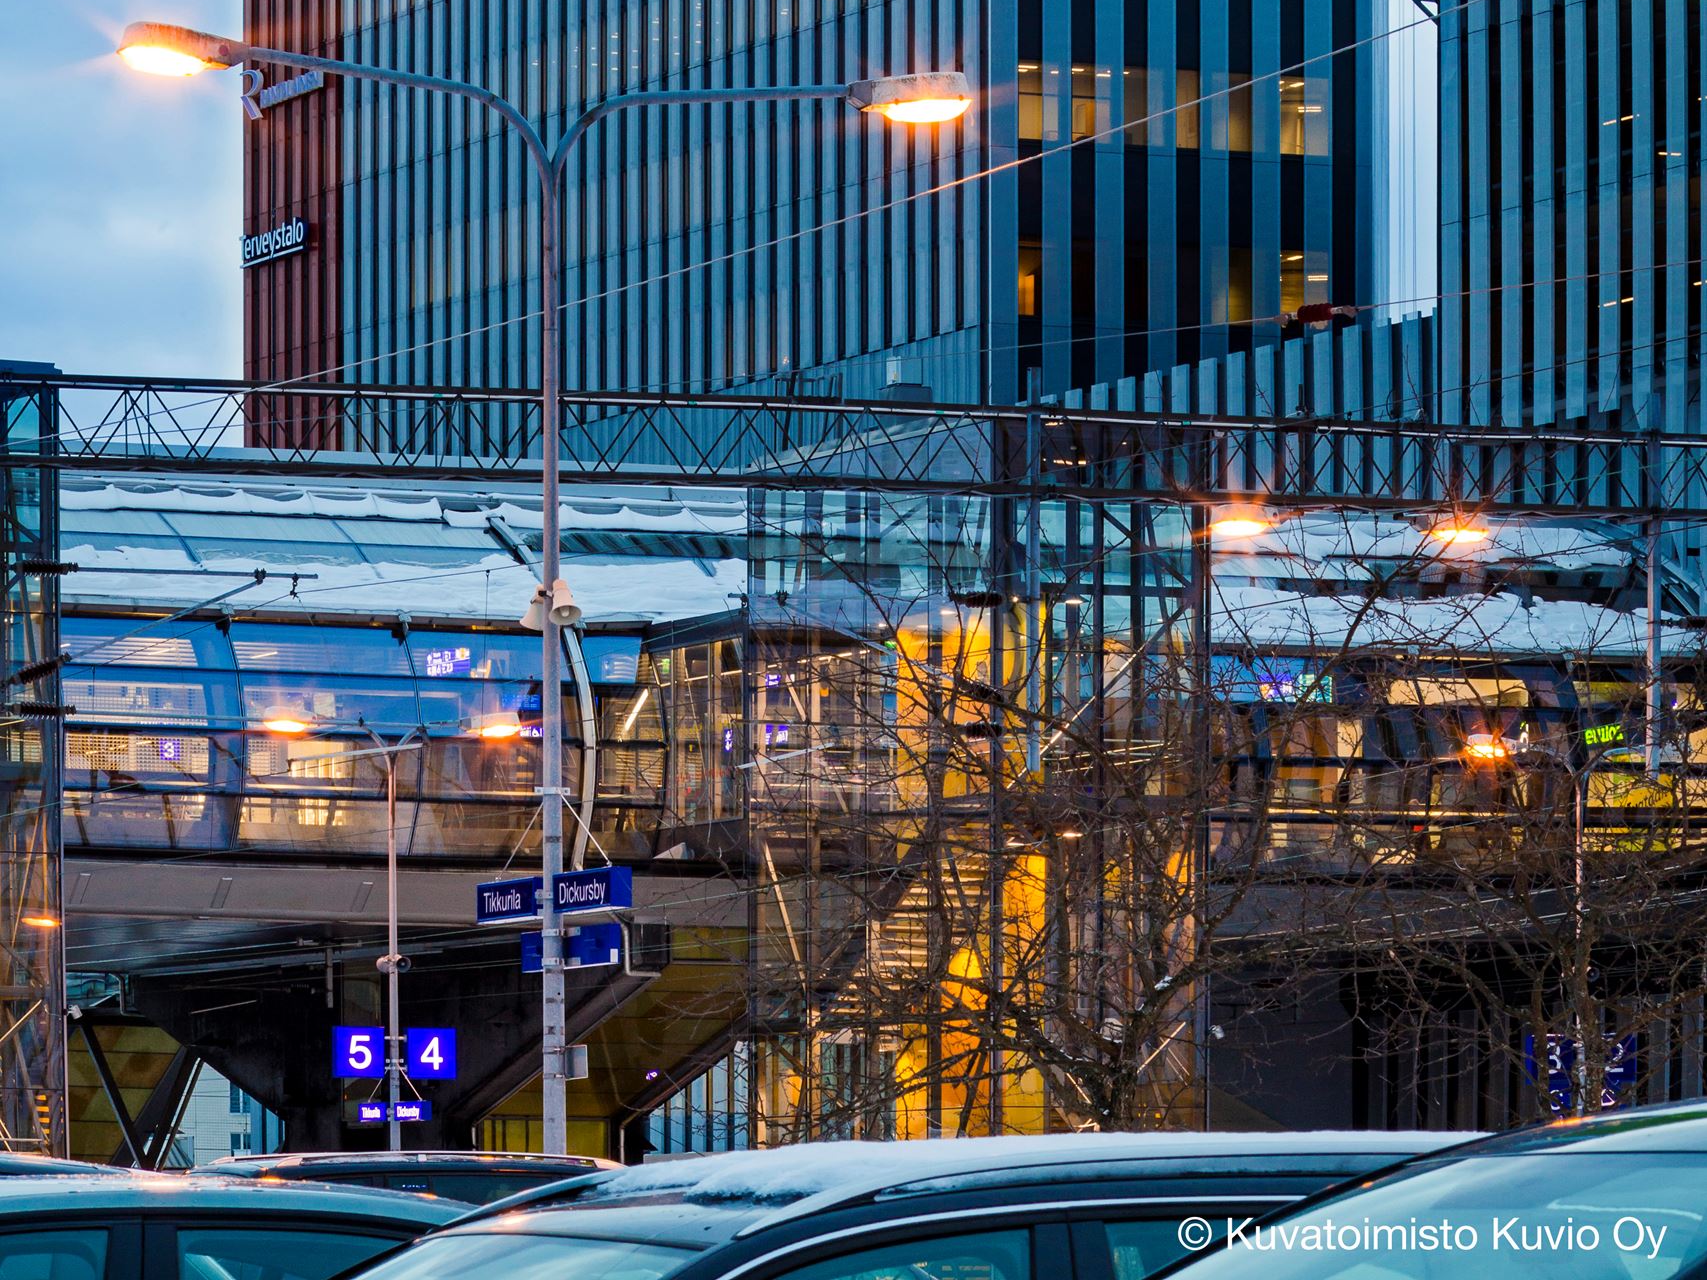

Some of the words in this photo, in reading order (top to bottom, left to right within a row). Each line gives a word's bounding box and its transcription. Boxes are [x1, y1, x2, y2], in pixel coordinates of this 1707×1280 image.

[239, 216, 304, 260] Terveystalo
[483, 888, 521, 914] Tikkurila
[558, 878, 606, 905] Dickursby
[348, 1034, 372, 1070] 5
[420, 1036, 444, 1071] 4
